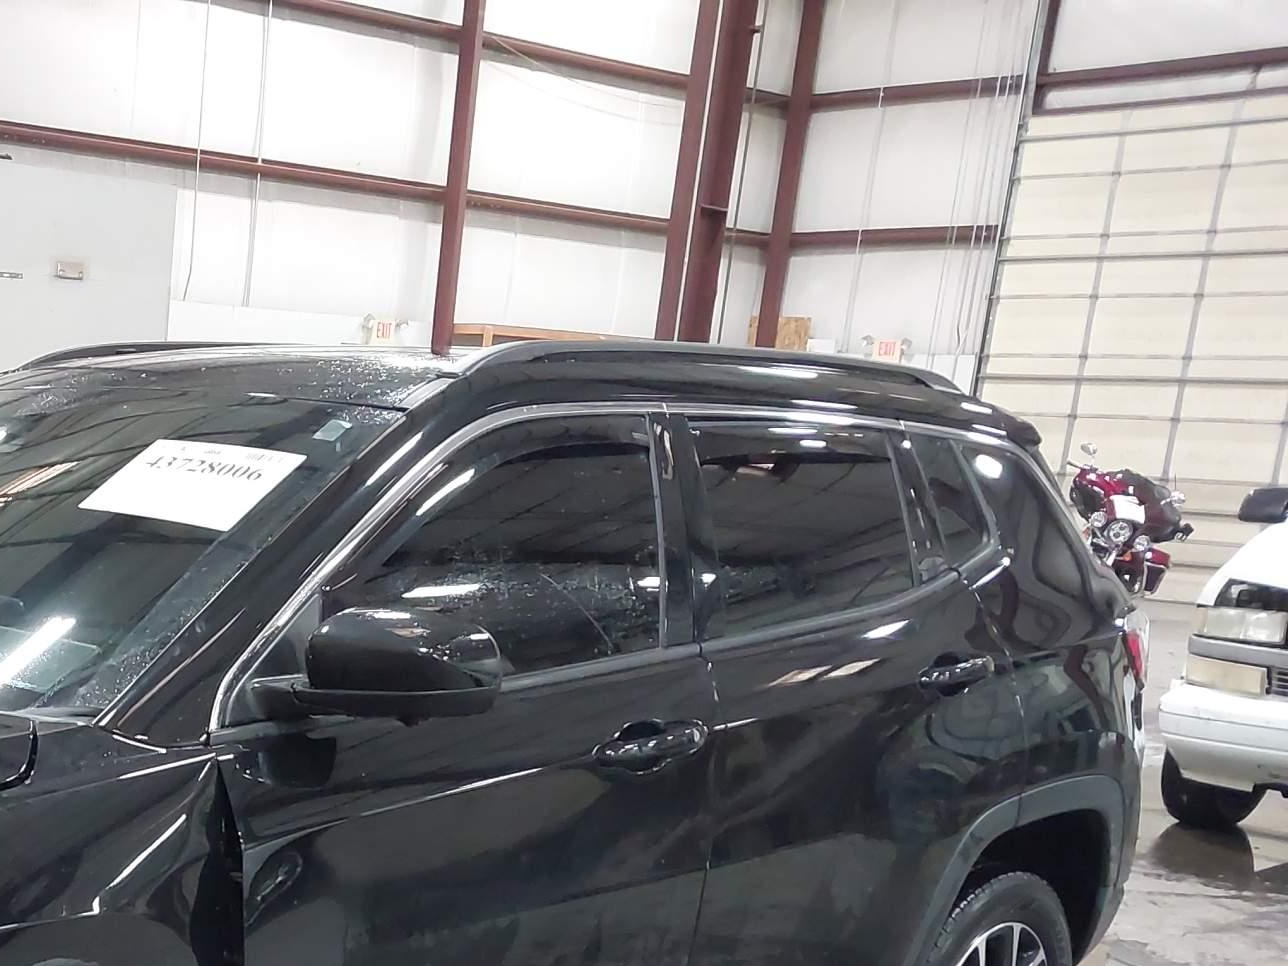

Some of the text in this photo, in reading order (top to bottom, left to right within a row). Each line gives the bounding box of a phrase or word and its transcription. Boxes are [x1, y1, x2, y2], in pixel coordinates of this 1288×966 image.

[376, 321, 393, 339] EXIT
[878, 340, 897, 357] EXIT
[146, 455, 263, 481] 43728006
